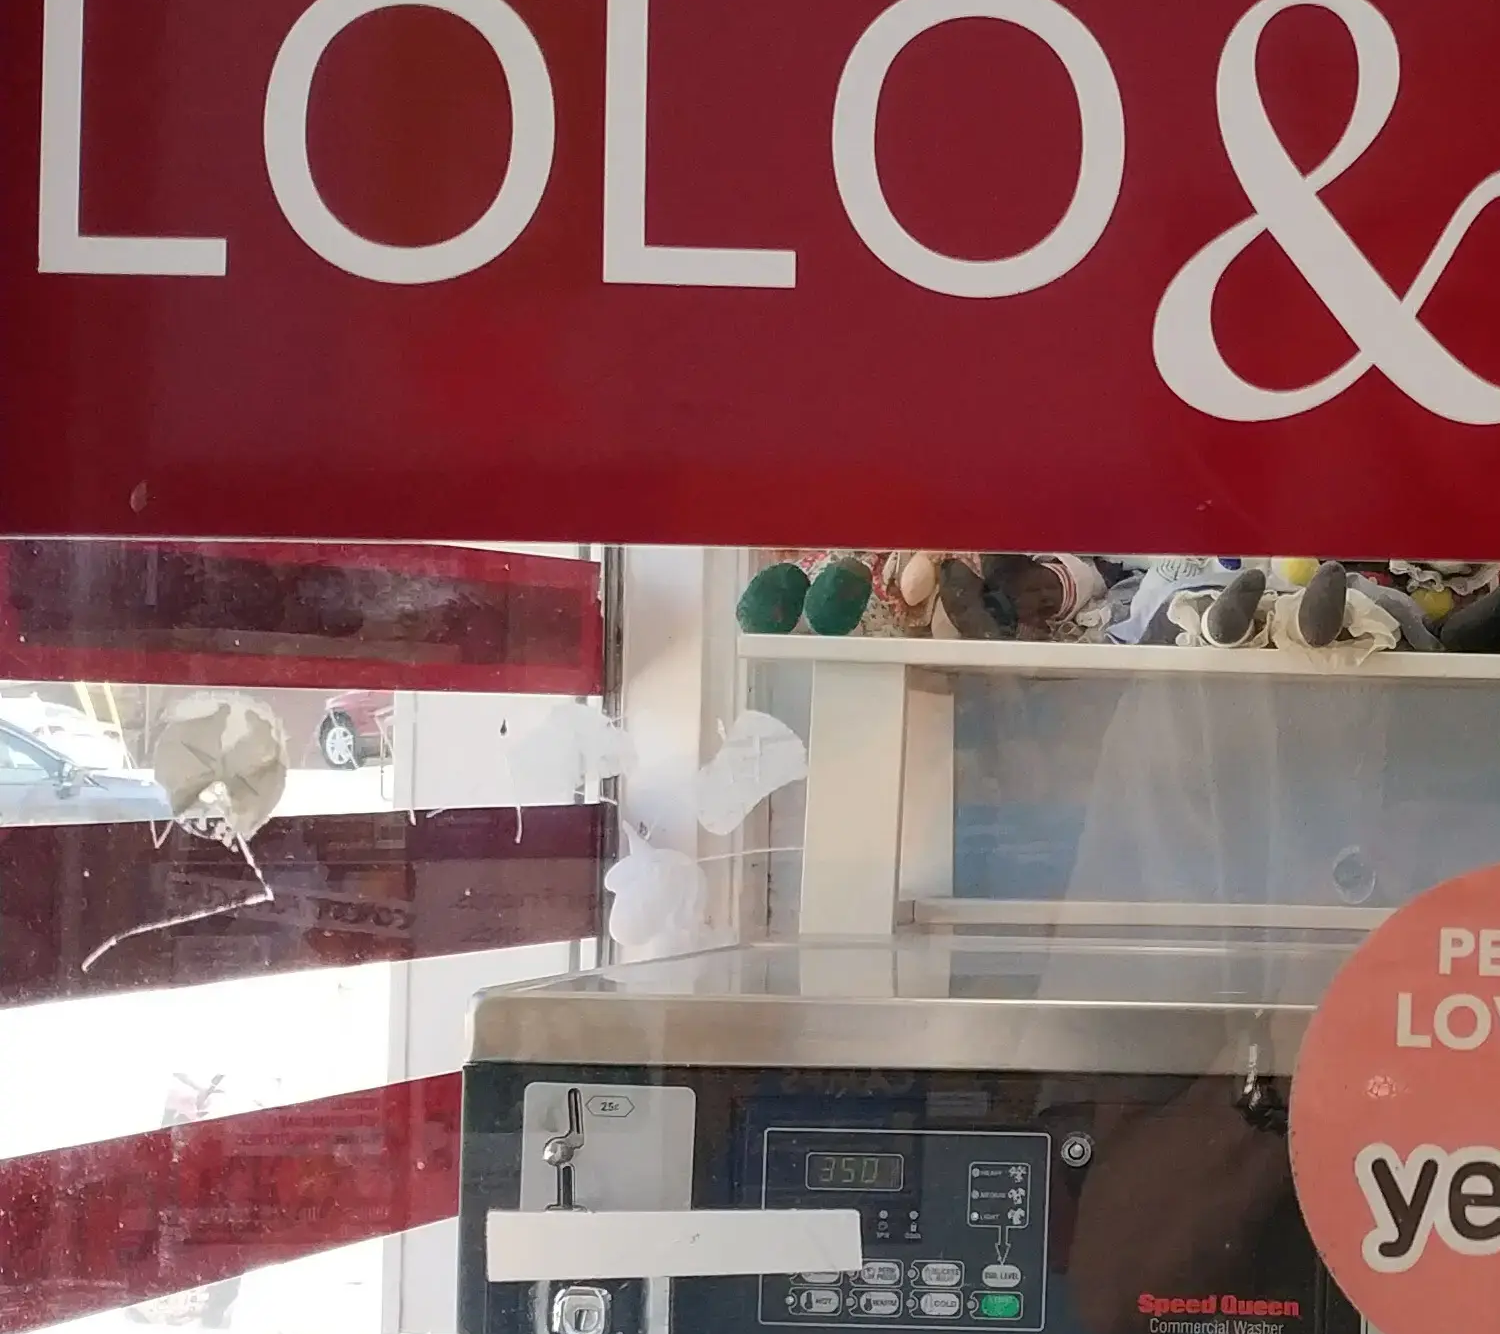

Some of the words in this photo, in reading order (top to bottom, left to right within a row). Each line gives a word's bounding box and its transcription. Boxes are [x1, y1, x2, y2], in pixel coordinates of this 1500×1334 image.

[819, 1156, 880, 1184] 350
[934, 1299, 957, 1308] COLD
[1137, 1293, 1217, 1317] Speed
[1220, 1294, 1300, 1317] Queen
[1150, 1318, 1229, 1334] Commercial
